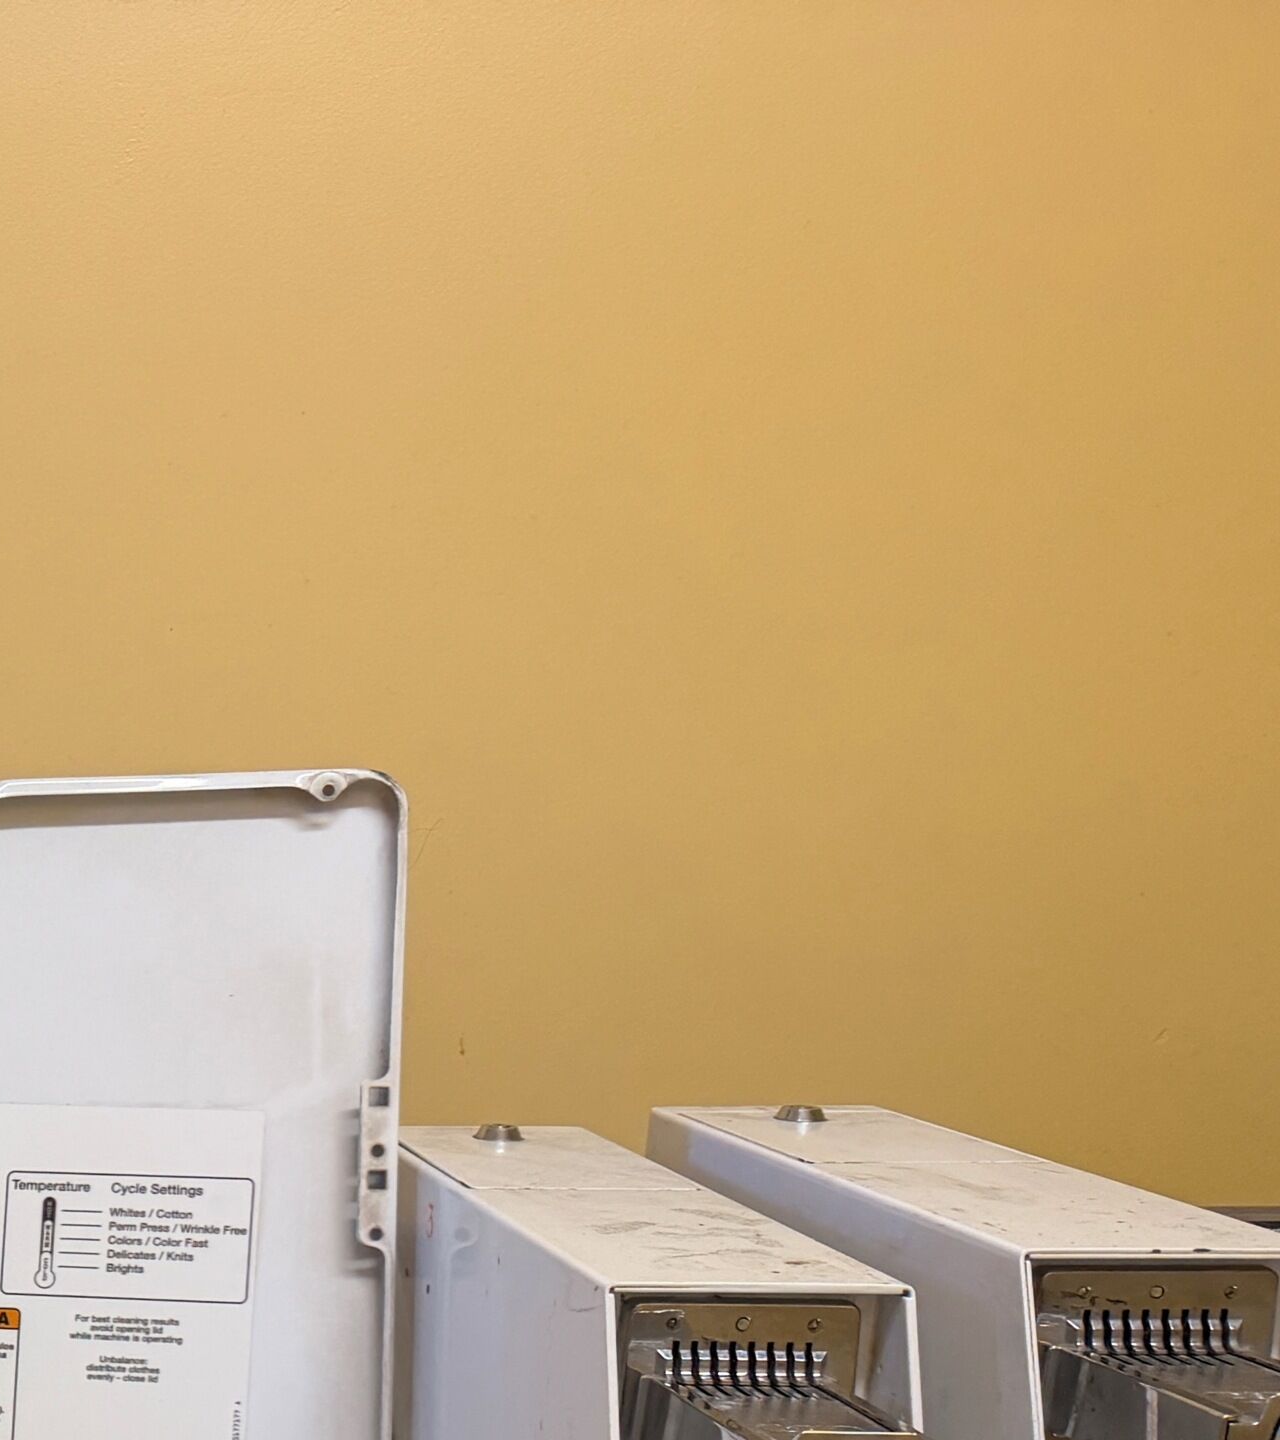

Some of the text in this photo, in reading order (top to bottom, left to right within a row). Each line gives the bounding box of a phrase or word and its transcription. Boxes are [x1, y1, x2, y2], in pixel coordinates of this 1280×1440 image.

[12, 1180, 91, 1194] Temperature
[111, 1183, 204, 1198] Cycle Settings
[109, 1208, 193, 1219] Whites / Cotton
[109, 1222, 247, 1234] Perm Press / Wrinkle Free
[107, 1236, 209, 1247] Colors / Color Fast
[106, 1250, 194, 1261] Delicates / Knits
[106, 1263, 144, 1275] Brights
[74, 1314, 180, 1326] For best cleaning results
[90, 1324, 163, 1335] avoid opening lid
[93, 1332, 130, 1341] machine
[141, 1334, 183, 1345] operating
[86, 1364, 160, 1374] distribute clothes
[86, 1373, 114, 1383] evenly
[122, 1374, 145, 1382] close
